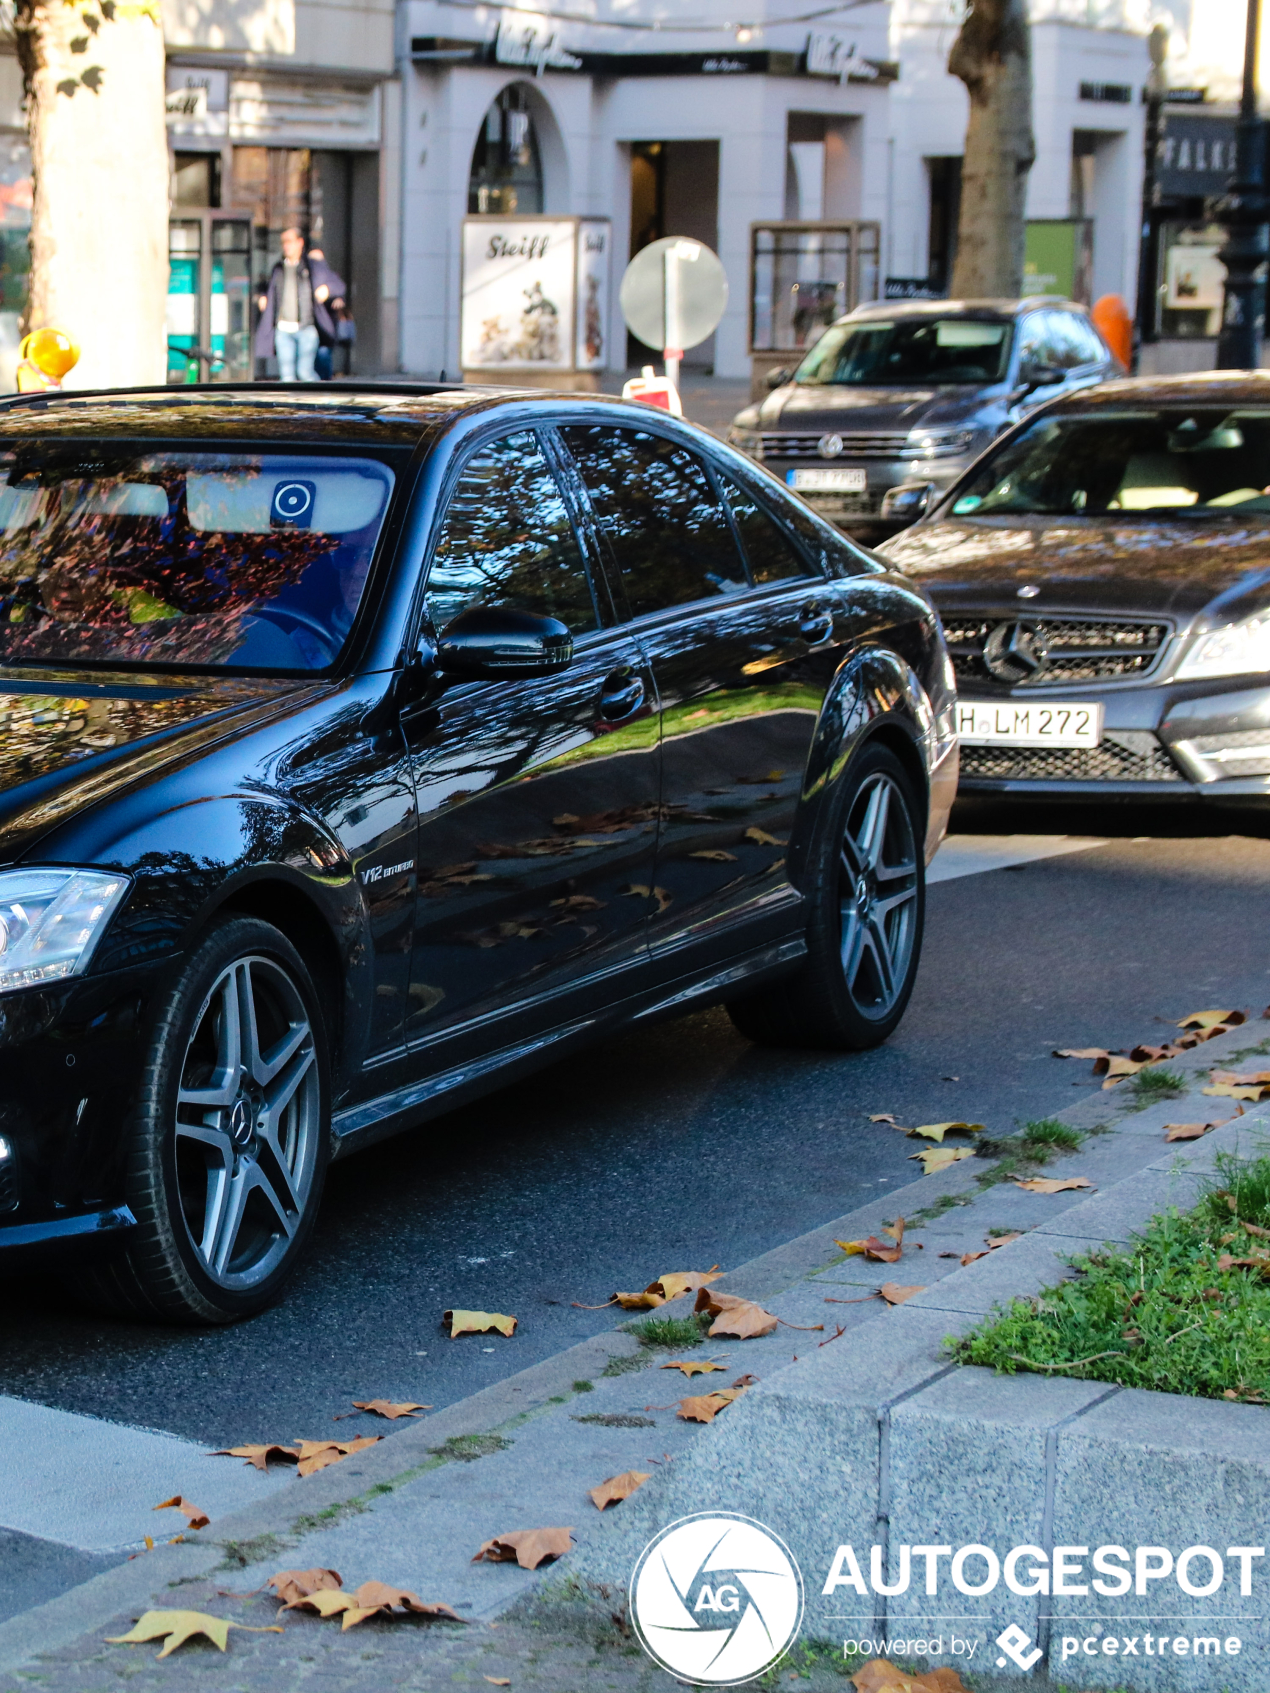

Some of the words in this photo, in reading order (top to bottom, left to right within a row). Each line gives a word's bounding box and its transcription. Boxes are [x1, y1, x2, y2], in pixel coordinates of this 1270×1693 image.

[166, 96, 199, 114] eiff
[487, 233, 550, 260] Steiff
[960, 709, 975, 733] H
[995, 709, 1030, 734] LM
[1038, 710, 1090, 735] 272
[360, 865, 383, 885] V12
[383, 860, 414, 878] BITURBO
